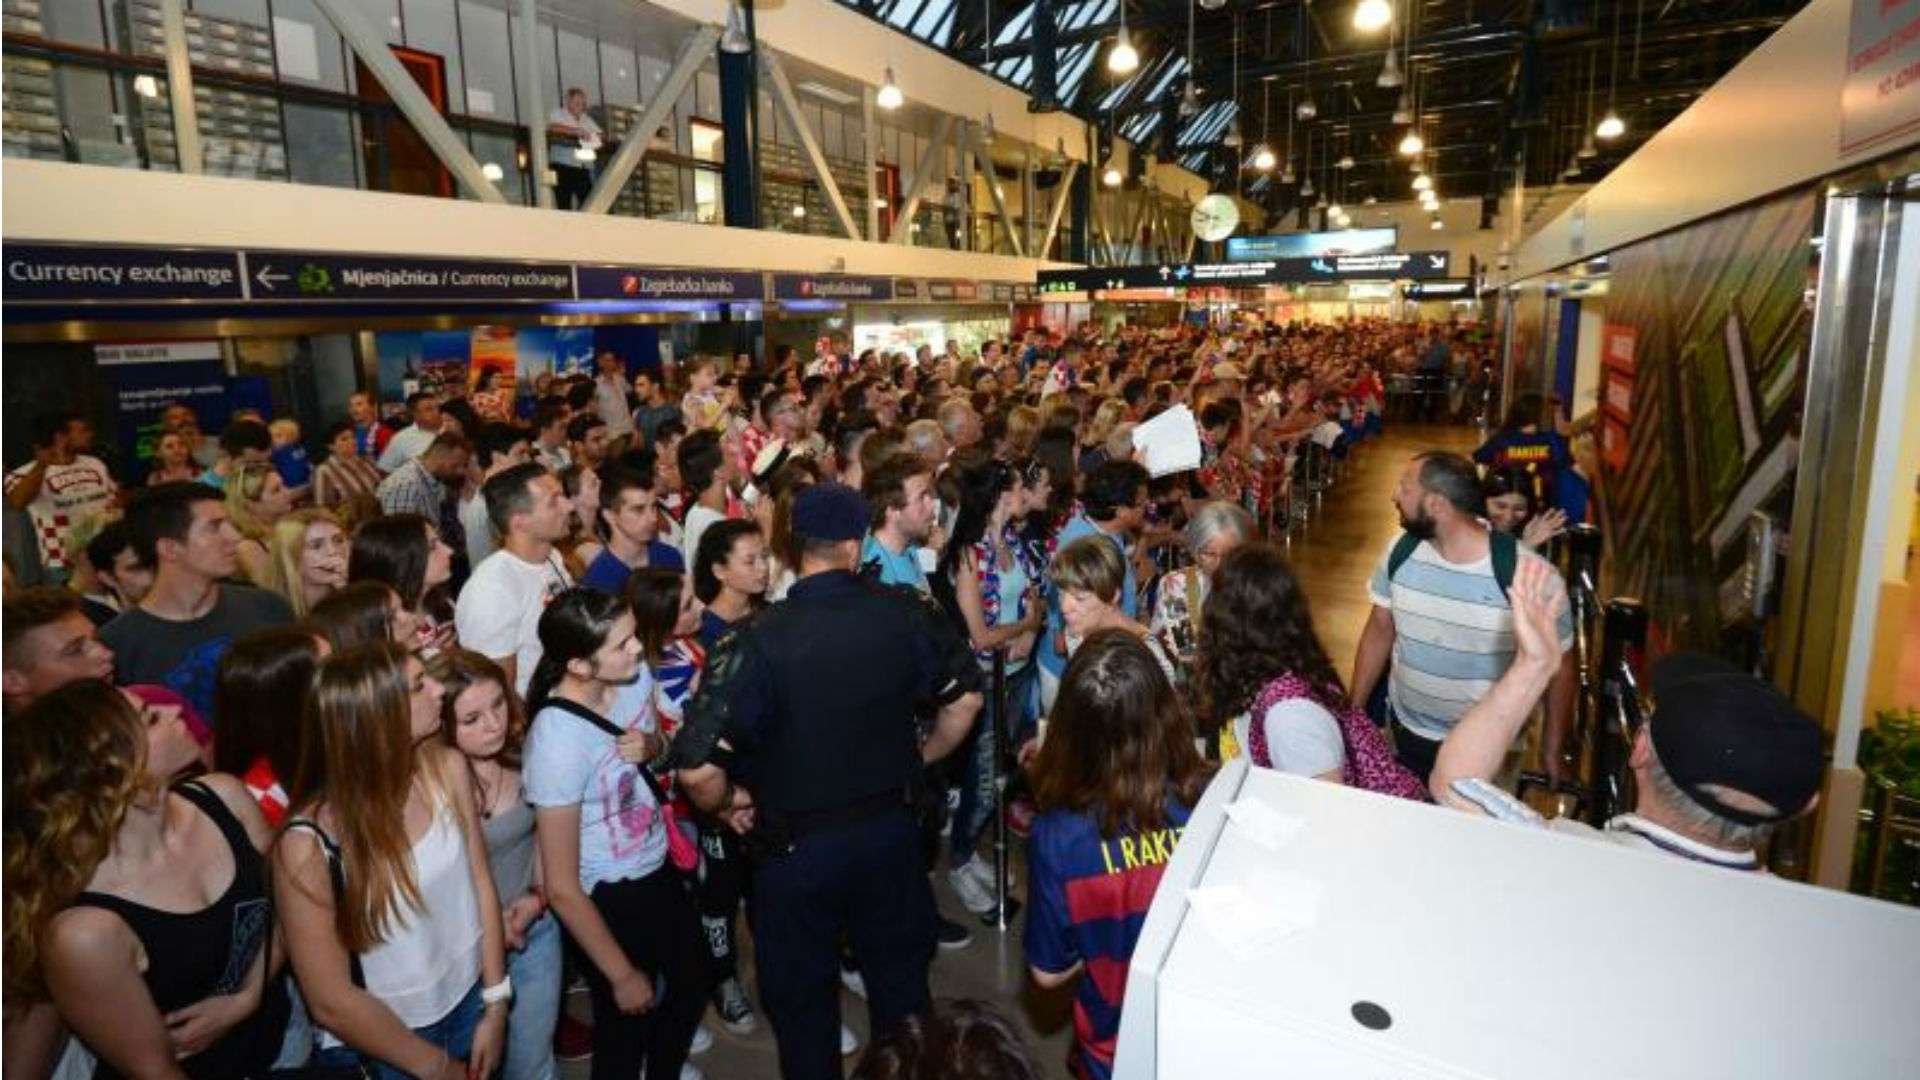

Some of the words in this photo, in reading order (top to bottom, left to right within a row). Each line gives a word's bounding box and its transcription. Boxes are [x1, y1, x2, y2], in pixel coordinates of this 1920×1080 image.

[9, 260, 122, 284] Currency
[130, 261, 233, 285] exchange
[450, 272, 508, 290] Currency
